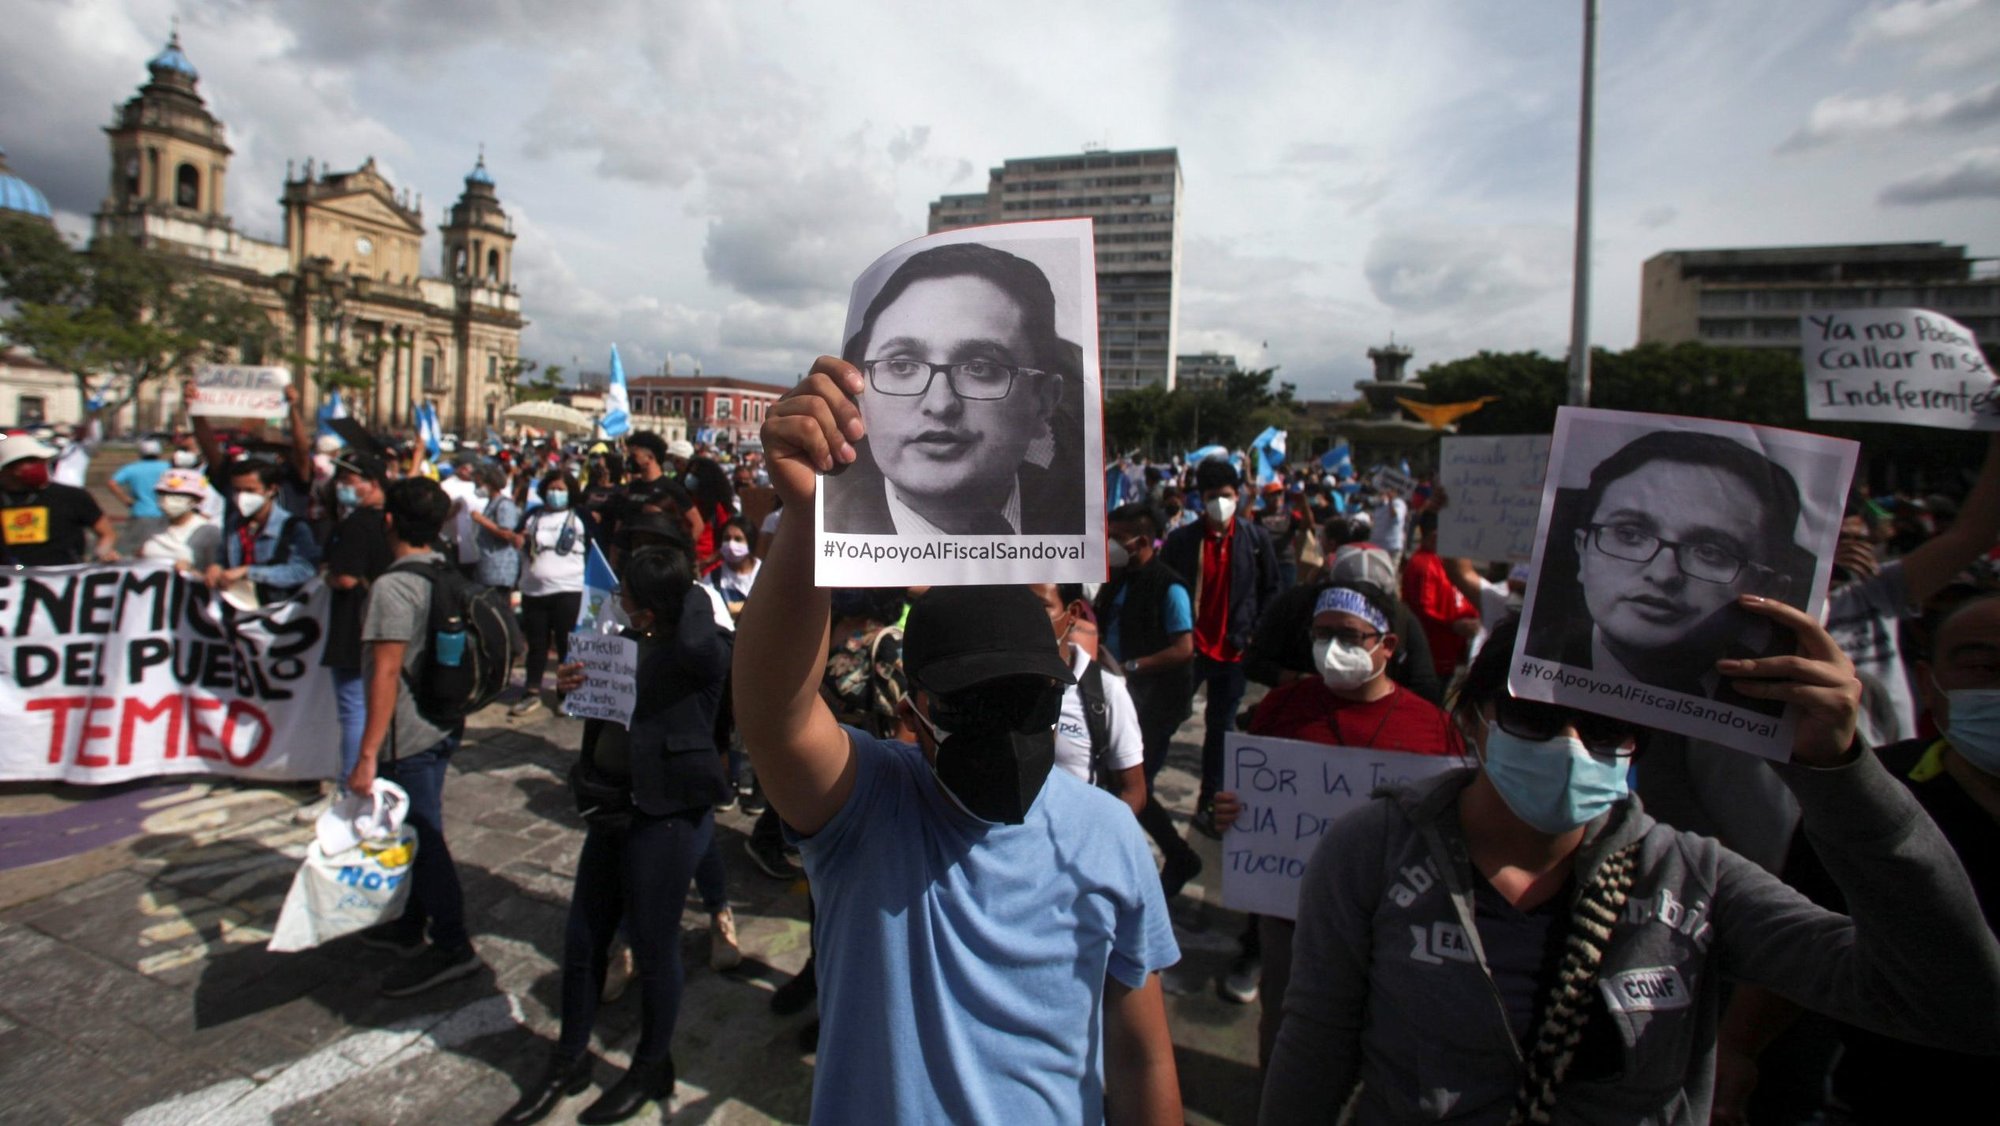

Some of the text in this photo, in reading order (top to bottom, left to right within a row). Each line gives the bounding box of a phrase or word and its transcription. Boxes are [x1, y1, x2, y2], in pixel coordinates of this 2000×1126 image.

[1808, 314, 1856, 341] Ya
[1864, 321, 1904, 340] no
[1819, 346, 1918, 370] Callar
[824, 540, 1085, 563] #YoApoyoAlFiscalSandoval
[1520, 660, 1779, 740] #YoApoyoAlFiscalSandoval
[1235, 747, 1297, 796] POR
[1624, 977, 1676, 999] CONF
